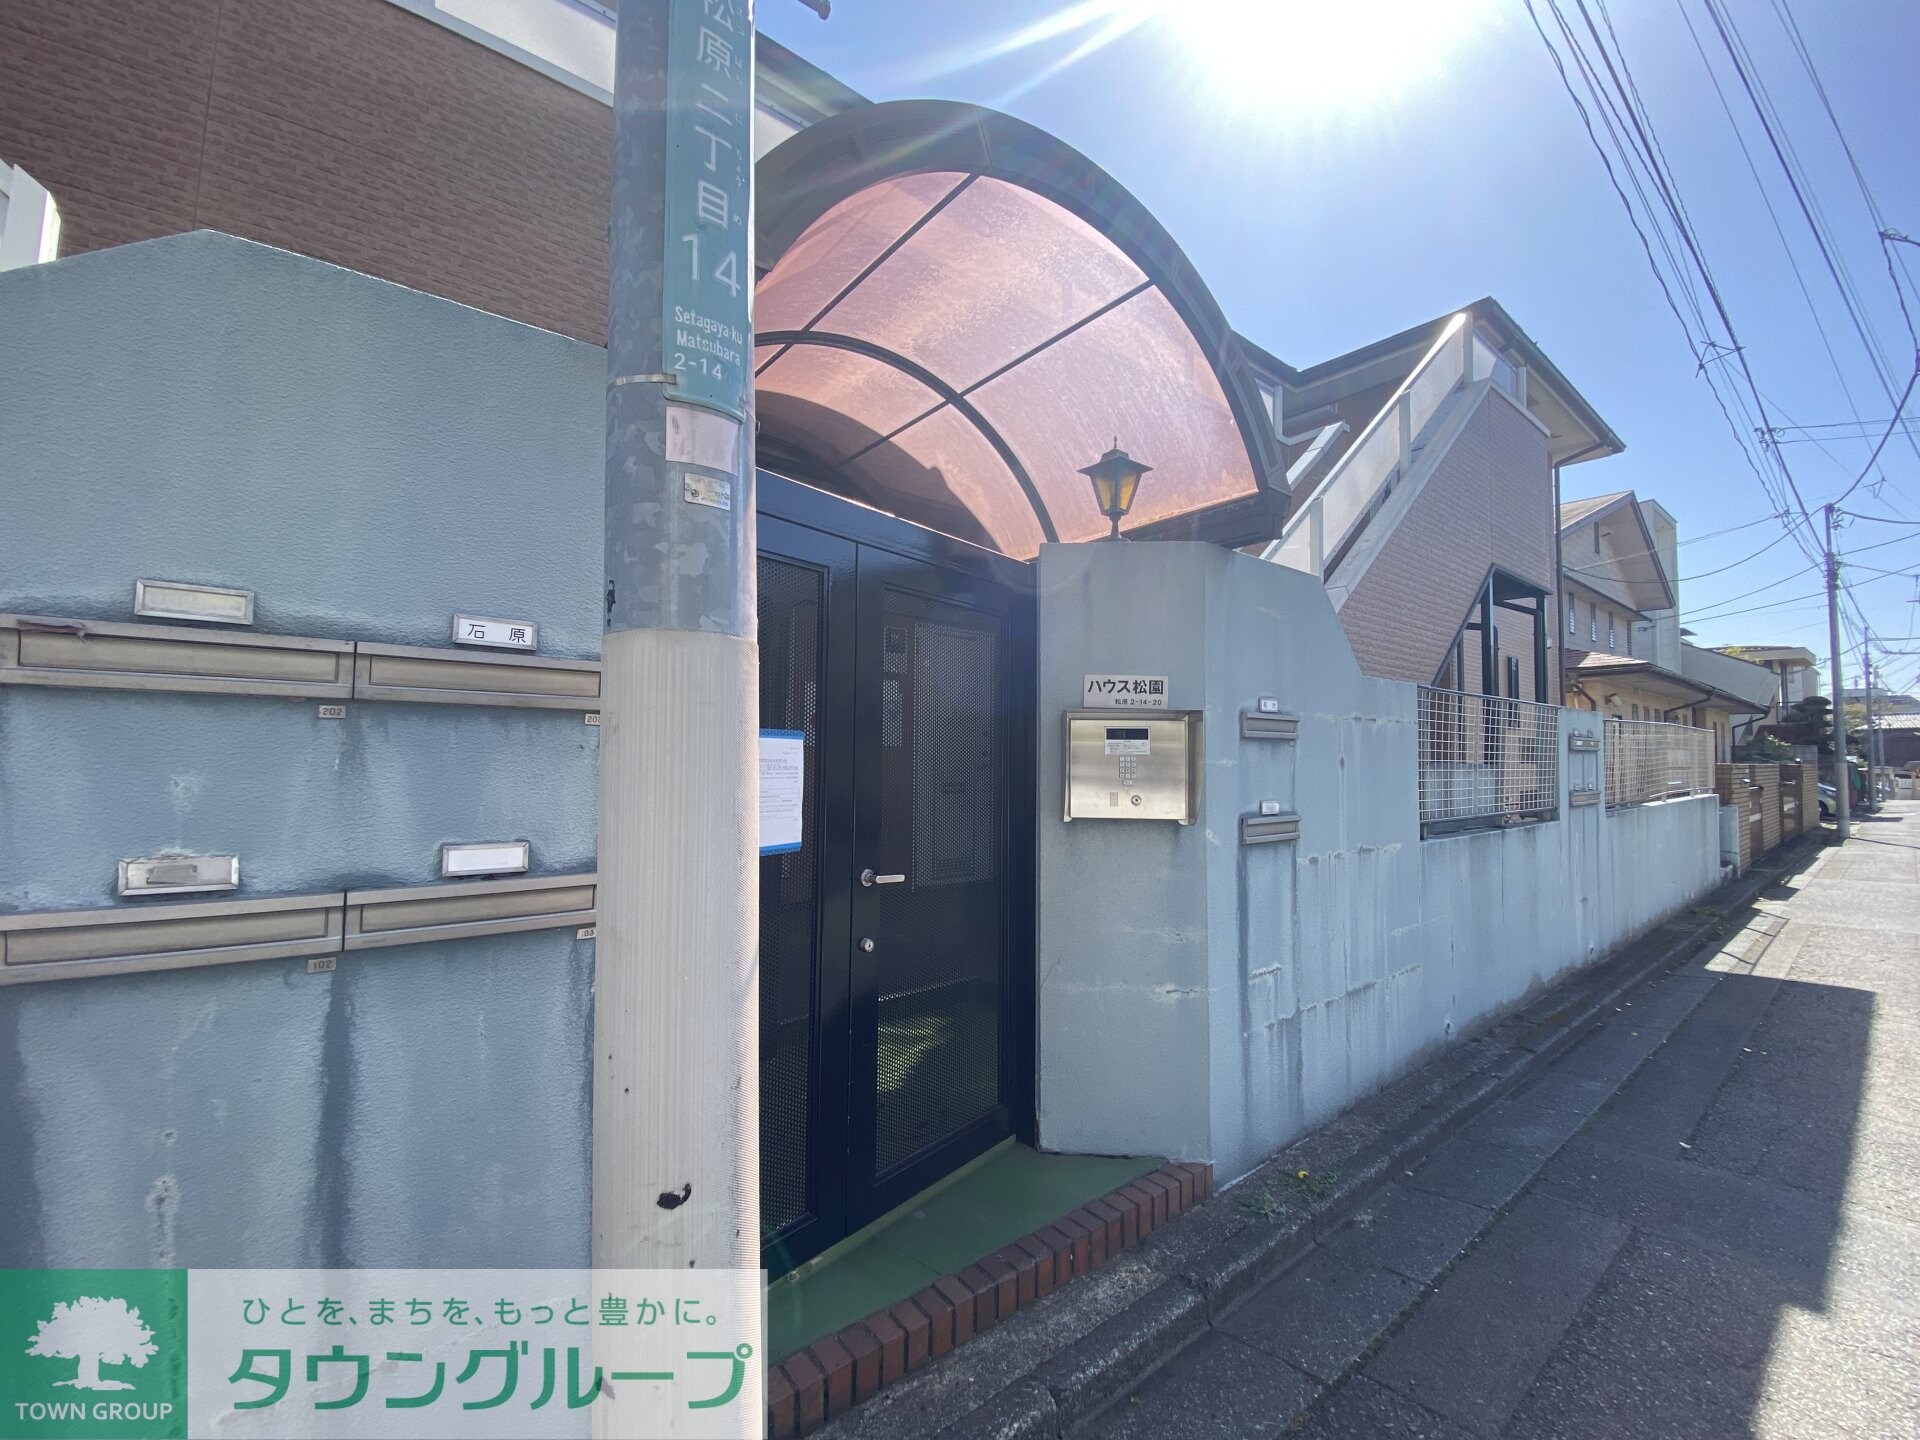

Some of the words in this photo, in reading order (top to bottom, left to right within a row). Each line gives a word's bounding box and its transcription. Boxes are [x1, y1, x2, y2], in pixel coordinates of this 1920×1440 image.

[682, 234, 741, 297] 14
[676, 329, 741, 367] Matsubara
[674, 352, 722, 380] 2-14
[1087, 679, 1164, 695] ハウス松園
[1130, 698, 1162, 706] 2-14-20
[322, 707, 343, 716] 202
[313, 960, 332, 969] 102
